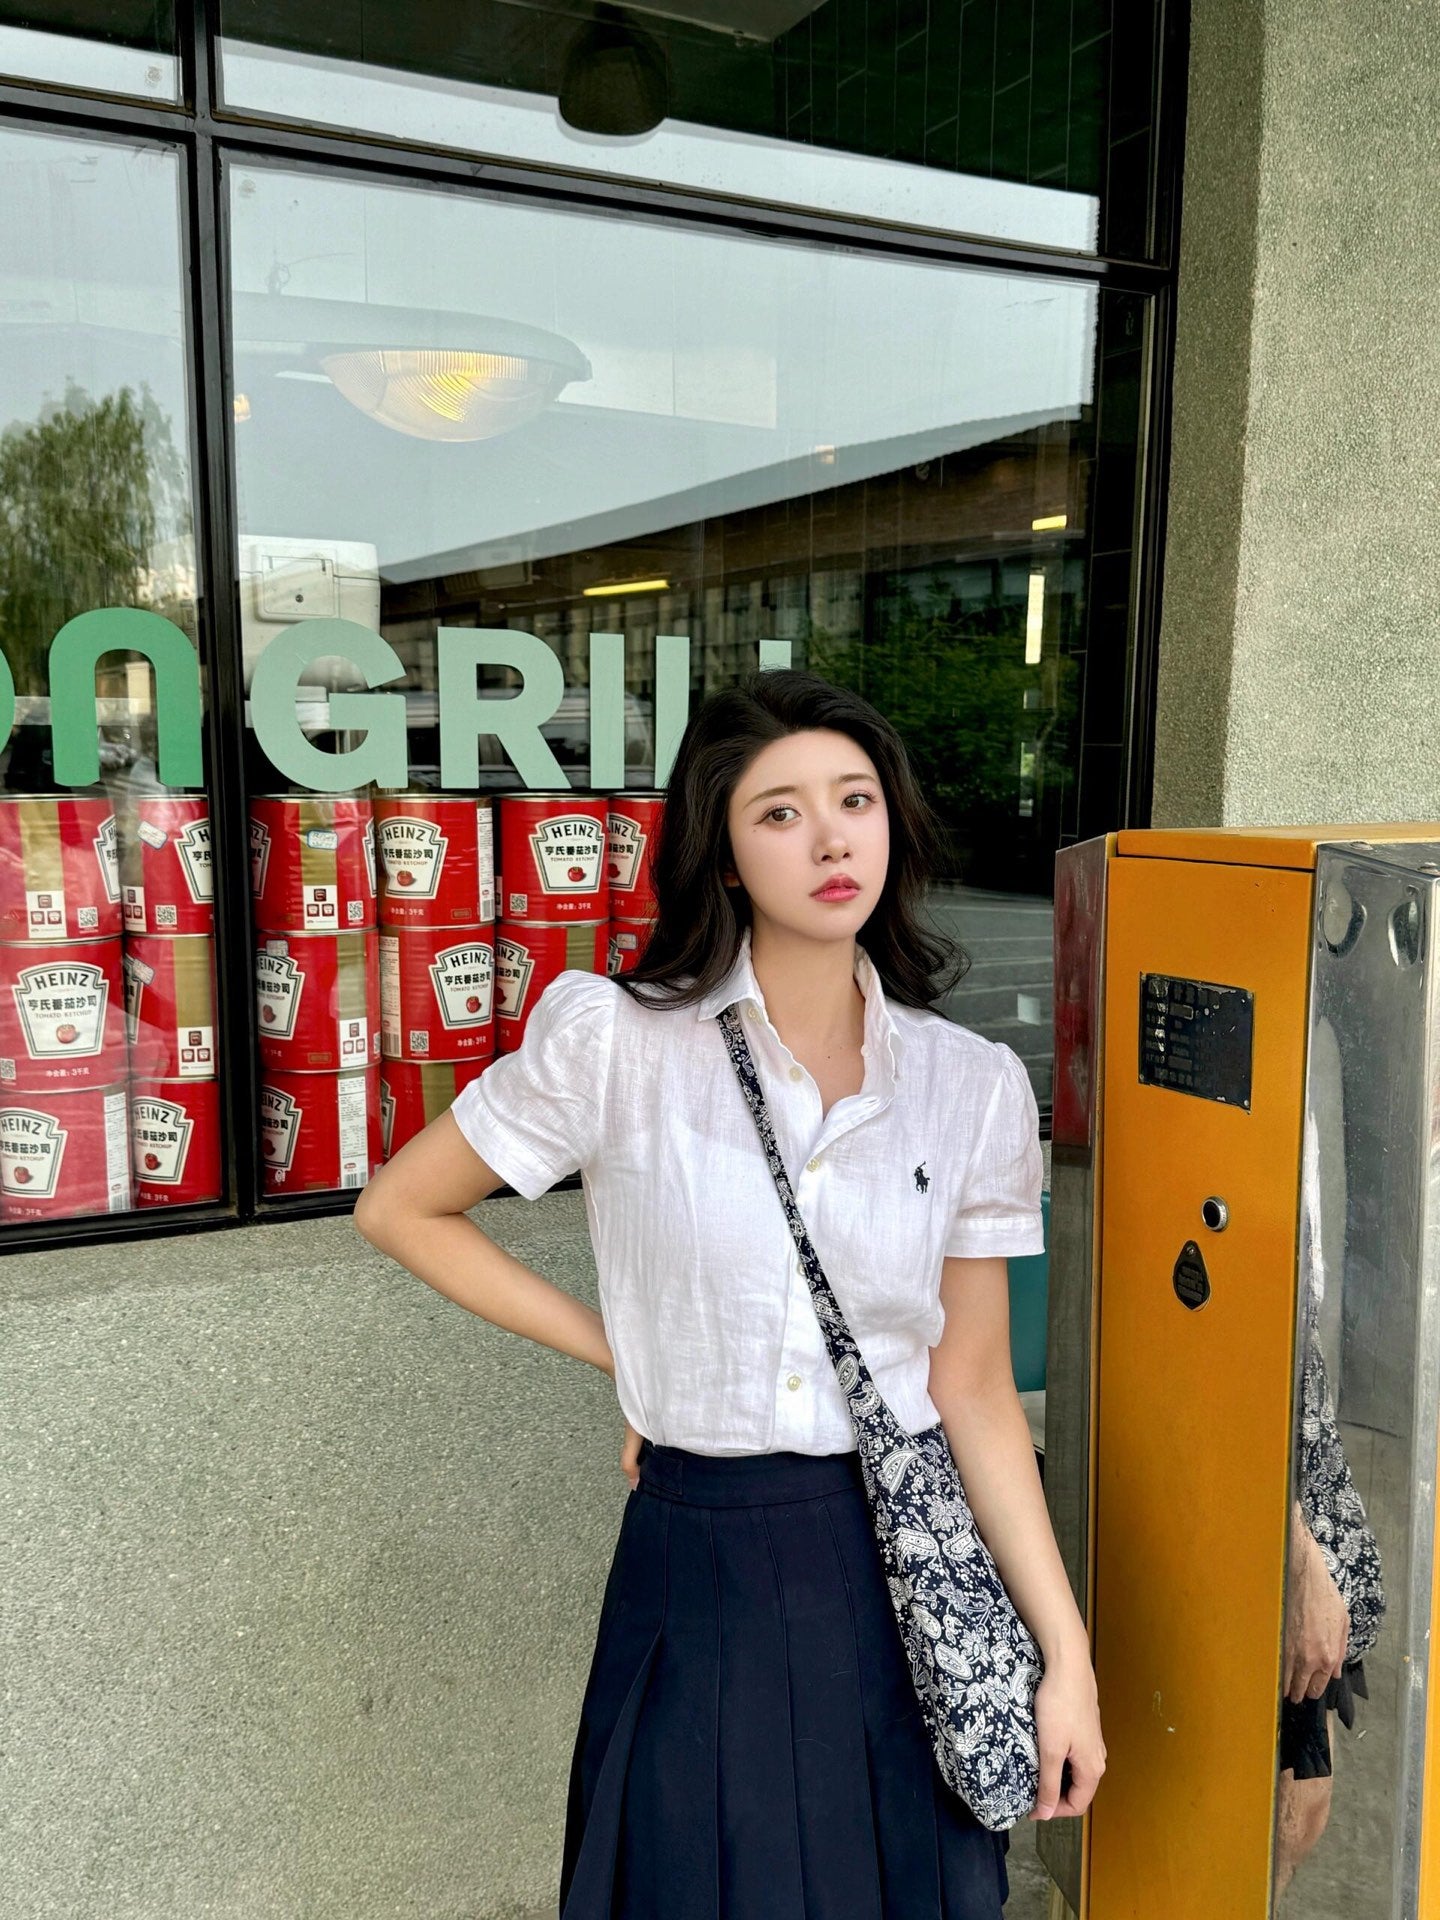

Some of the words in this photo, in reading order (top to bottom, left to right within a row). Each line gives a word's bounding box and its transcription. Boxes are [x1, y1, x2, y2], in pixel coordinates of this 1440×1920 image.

[385, 826, 426, 841] HEINZ
[551, 823, 594, 839] HEINZ
[608, 822, 629, 838] INZ
[544, 844, 598, 856] 亨氏番茄沙司
[450, 952, 488, 968] HEINZ
[496, 945, 515, 961] INZ
[258, 957, 284, 975] EINZ
[33, 972, 89, 990] HEINZ
[444, 971, 491, 986] 亨氏番茄沙司
[28, 995, 97, 1011] 亨氏番茄沙司
[1, 1117, 42, 1136] HEINZ
